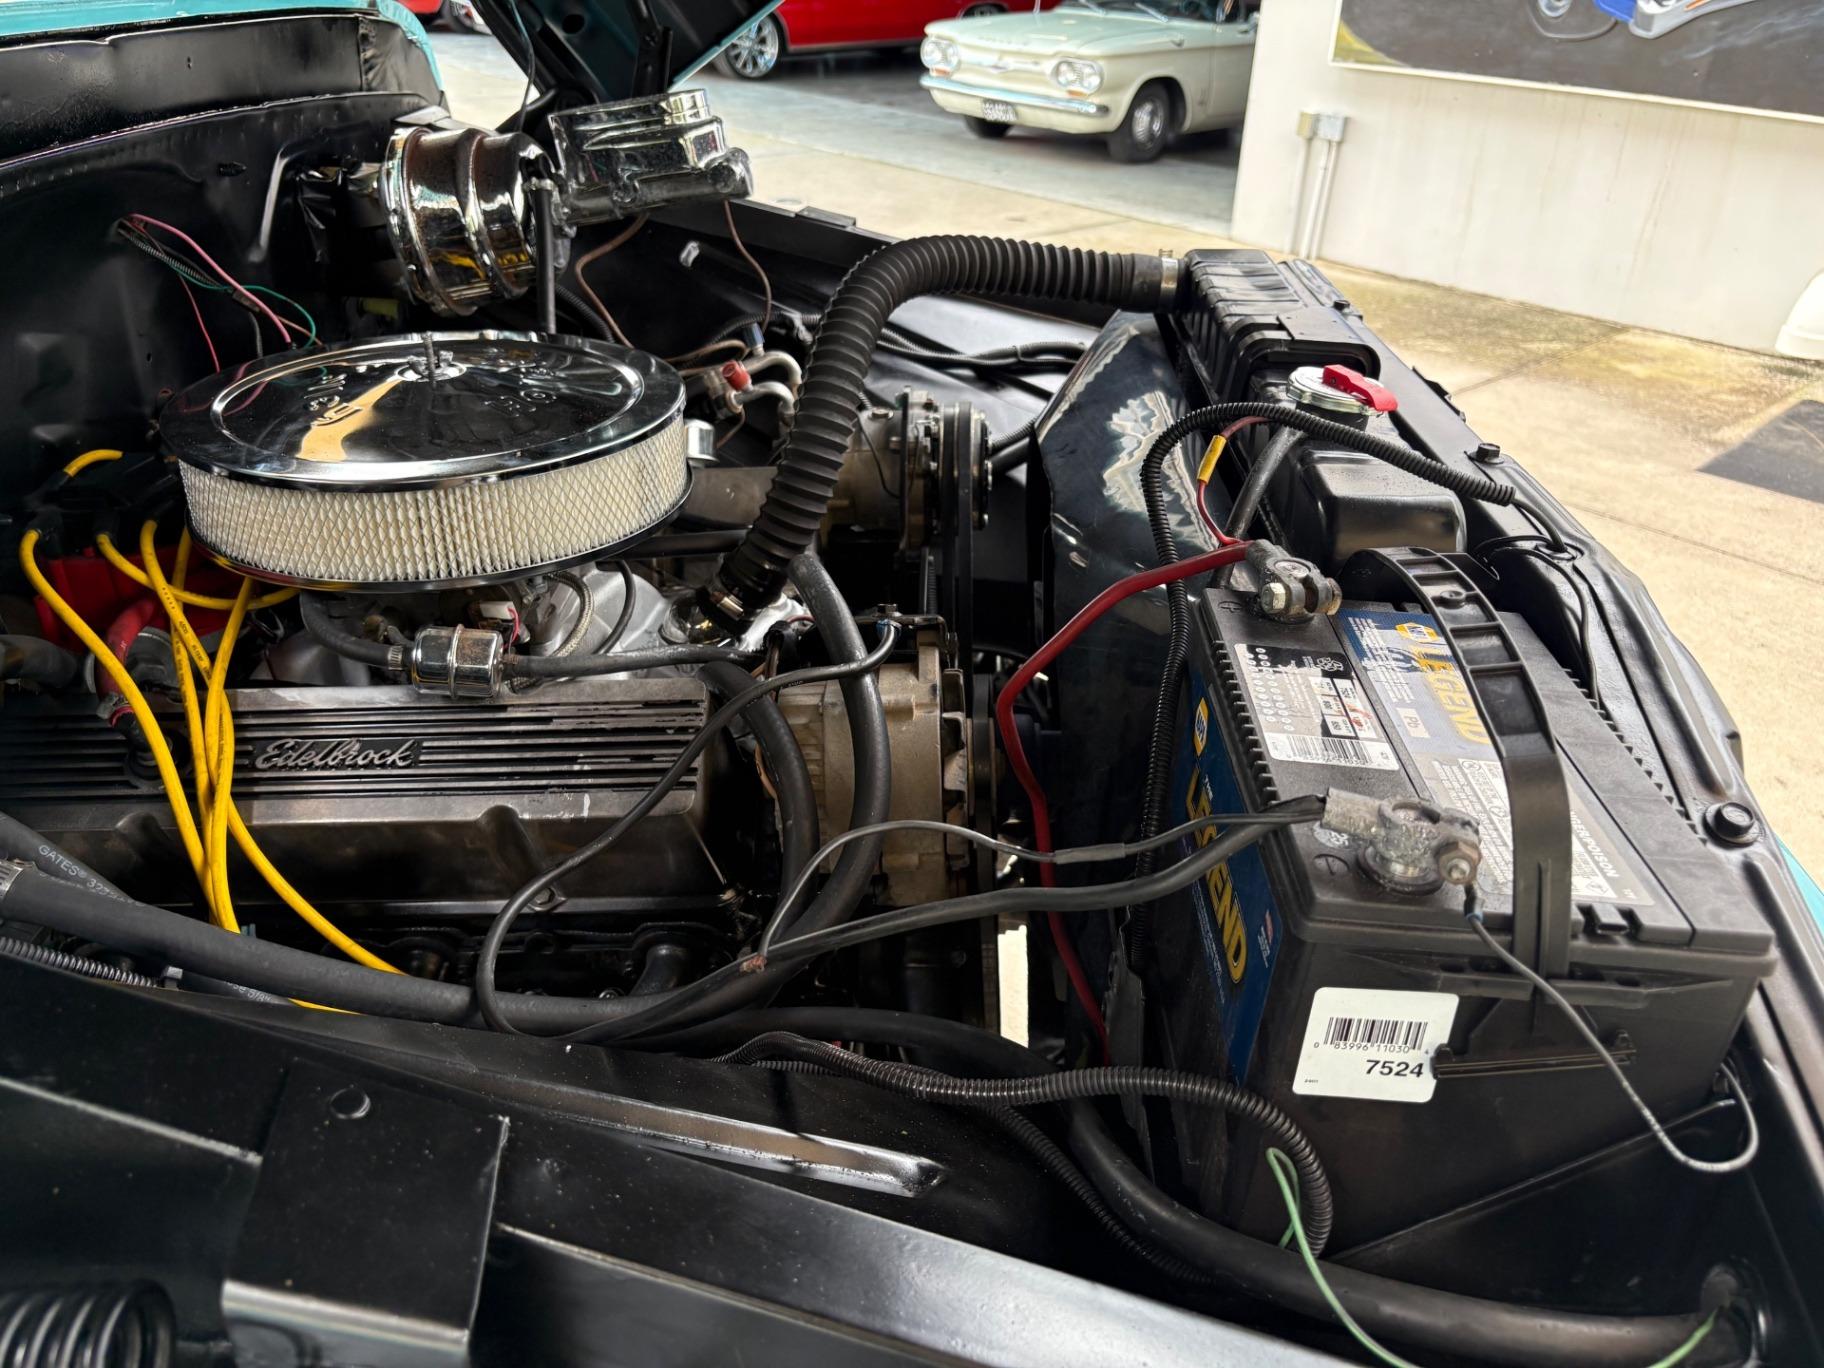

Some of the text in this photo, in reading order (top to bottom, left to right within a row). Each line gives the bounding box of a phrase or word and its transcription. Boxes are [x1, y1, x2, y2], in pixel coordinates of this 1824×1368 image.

[1409, 645, 1492, 745] LEGEND
[255, 738, 415, 770] Edelbrock
[1570, 811, 1620, 878] GER/POISON
[1313, 1041, 1320, 1049] 0
[1333, 1042, 1369, 1052] 83996
[1376, 1044, 1411, 1054] 11030
[1365, 1059, 1424, 1078] 7524
